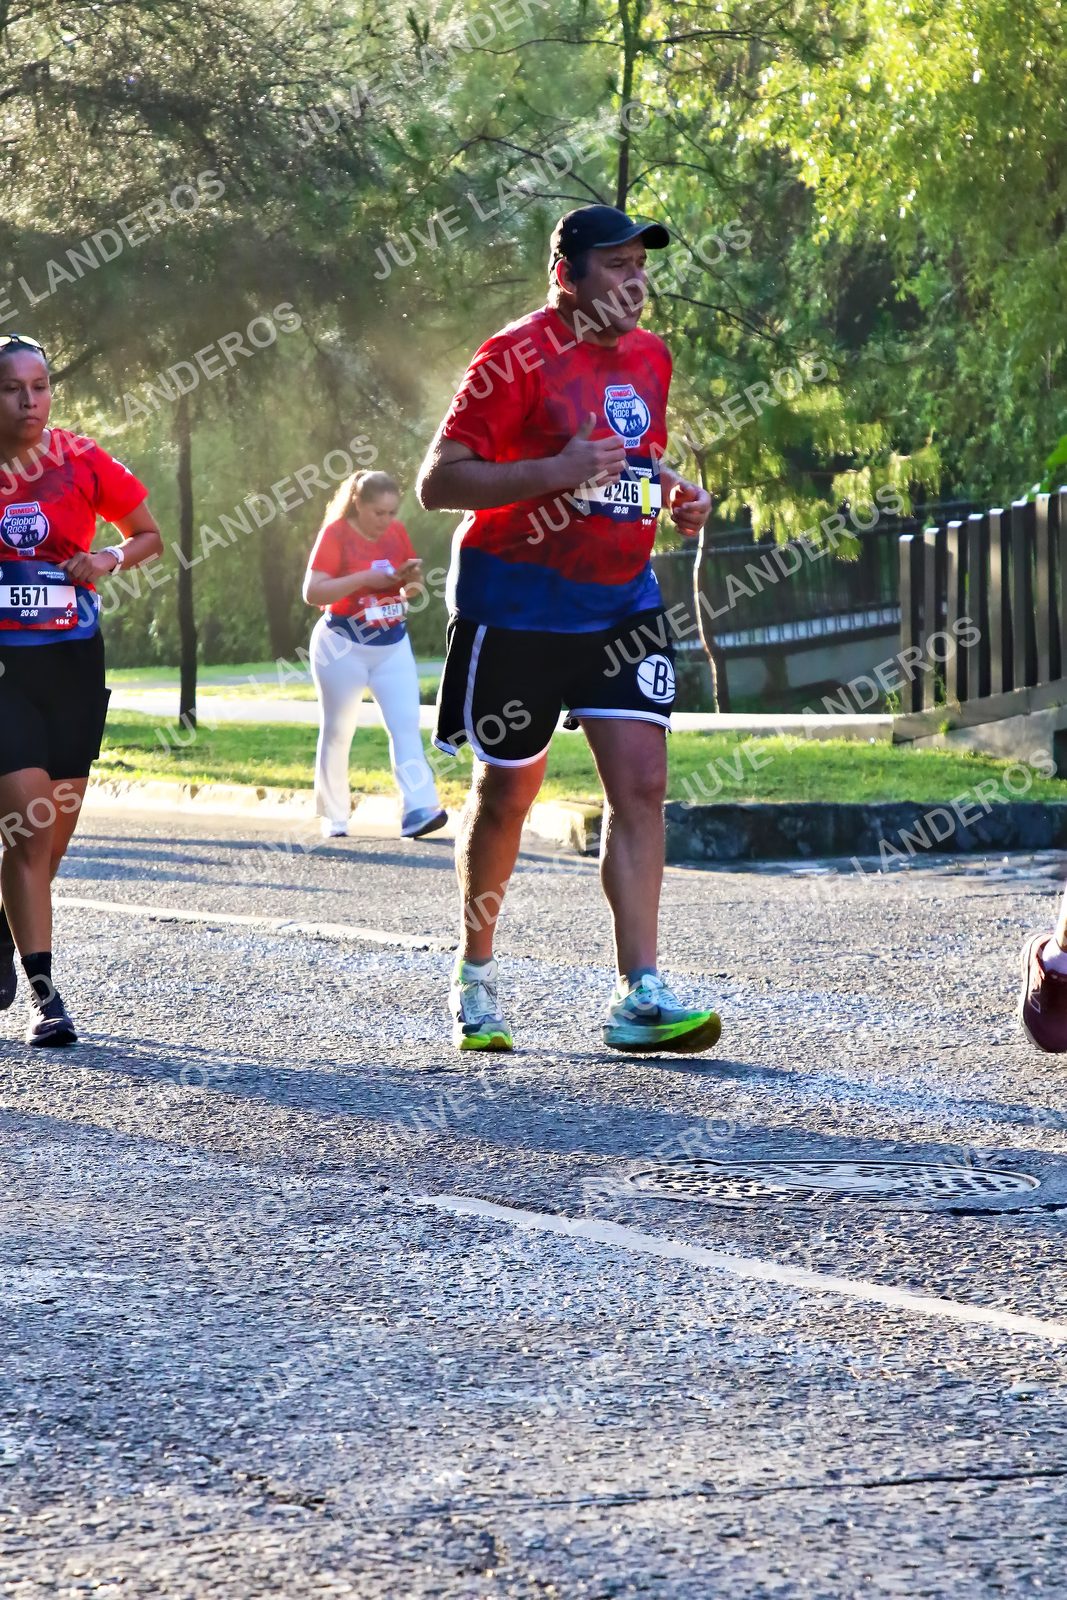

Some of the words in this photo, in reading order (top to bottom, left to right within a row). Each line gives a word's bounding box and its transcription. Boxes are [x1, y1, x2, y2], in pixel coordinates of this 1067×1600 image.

[614, 400, 636, 409] Global
[613, 409, 630, 418] Race
[604, 482, 639, 503] 4246
[11, 516, 37, 527] Global
[7, 526, 27, 534] Race
[10, 586, 48, 606] 5571
[653, 660, 668, 697] B
